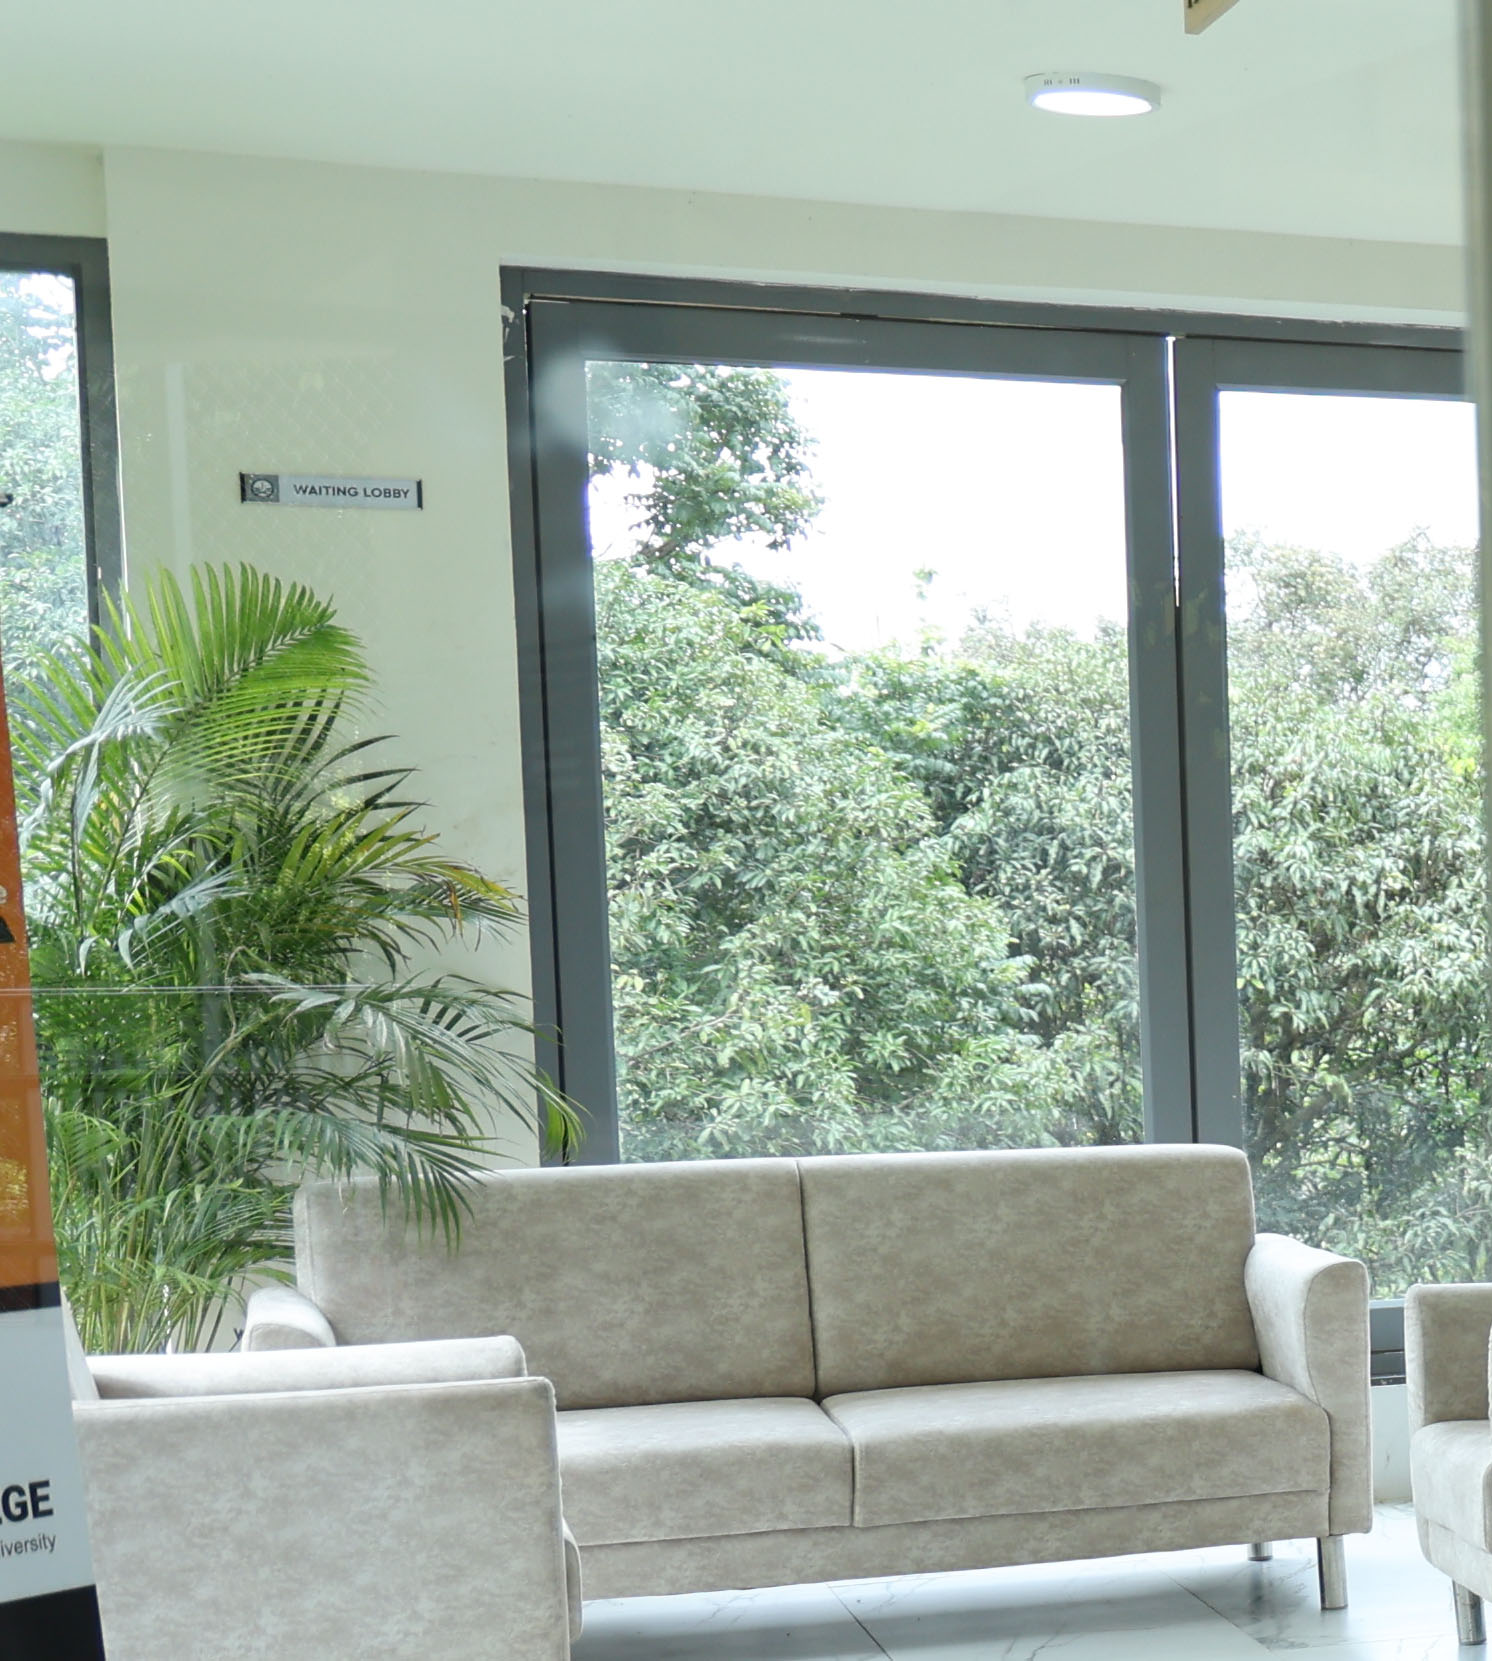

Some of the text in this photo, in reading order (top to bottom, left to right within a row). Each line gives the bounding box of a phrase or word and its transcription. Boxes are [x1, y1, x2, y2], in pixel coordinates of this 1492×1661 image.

[293, 484, 410, 499] WAITING LOBBY
[0, 1479, 54, 1525] GE
